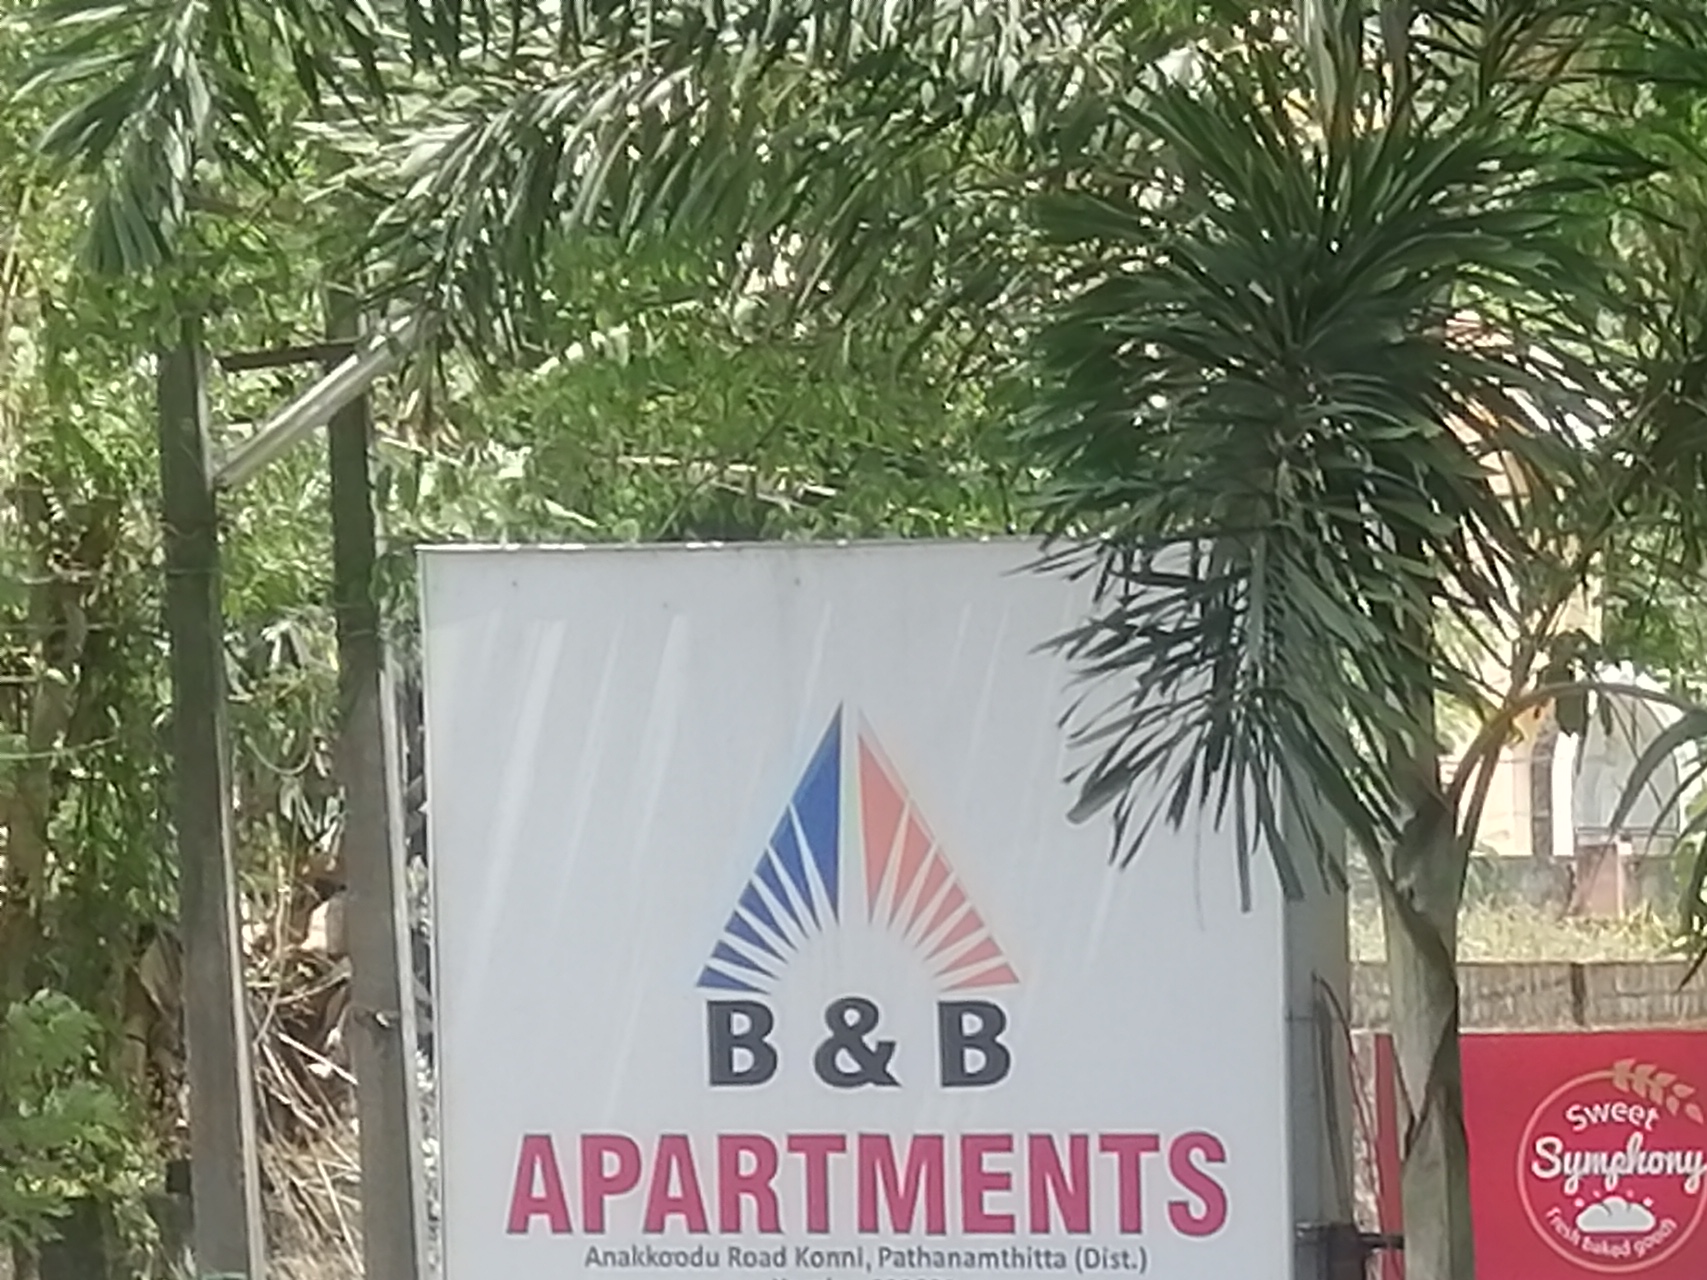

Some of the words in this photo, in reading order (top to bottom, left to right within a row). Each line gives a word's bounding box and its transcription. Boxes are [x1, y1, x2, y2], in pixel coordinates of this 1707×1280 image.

[706, 999, 778, 1087] B
[814, 997, 902, 1089] &
[937, 1000, 1012, 1088] B
[1565, 1101, 1660, 1132] Sweet
[506, 1131, 1228, 1237] APARTMENTS
[584, 1245, 720, 1268] Anakkoodu
[727, 1247, 787, 1268] Road
[795, 1248, 872, 1274] Konni,
[877, 1247, 1067, 1270] Pathanamthitta
[1074, 1246, 1148, 1274] (Dist.)
